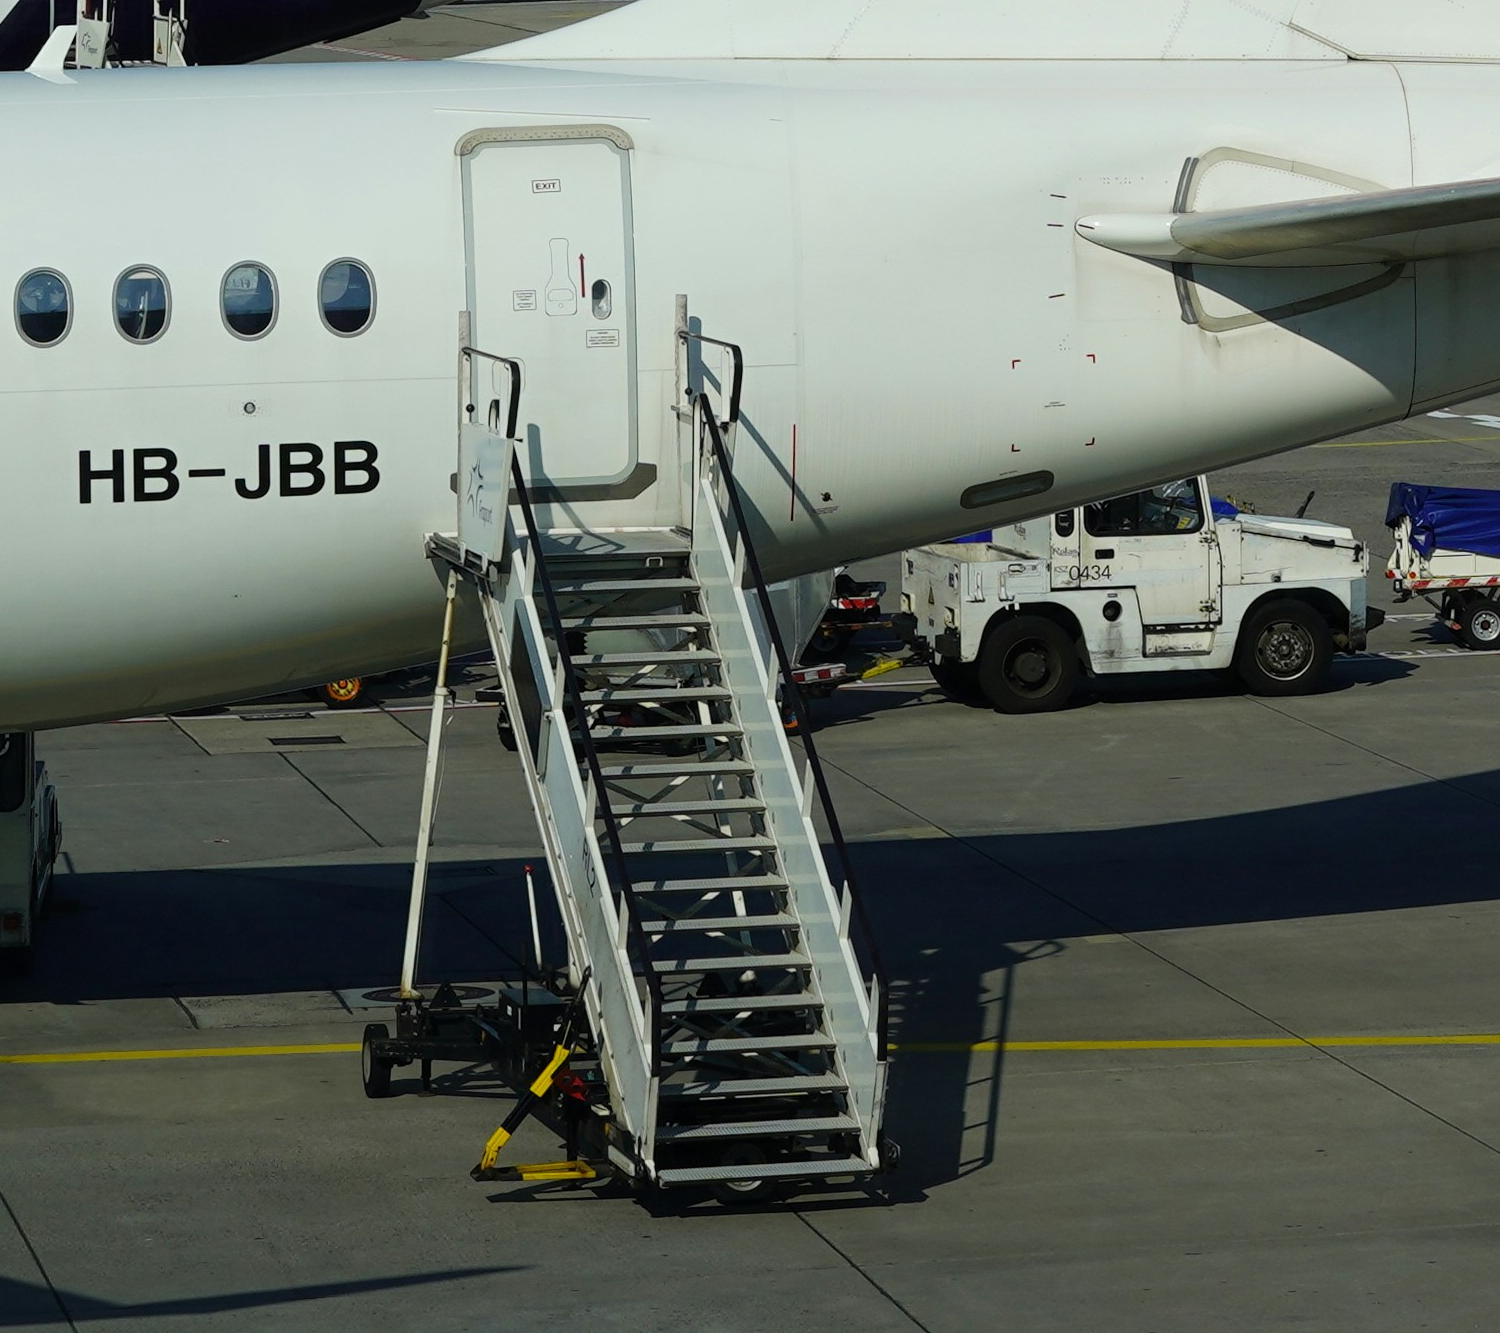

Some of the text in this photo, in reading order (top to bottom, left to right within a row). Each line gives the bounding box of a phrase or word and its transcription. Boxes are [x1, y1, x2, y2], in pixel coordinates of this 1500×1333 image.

[535, 182, 557, 190] EXIT
[78, 440, 381, 505] HB-JBB
[1069, 564, 1113, 581] 0434
